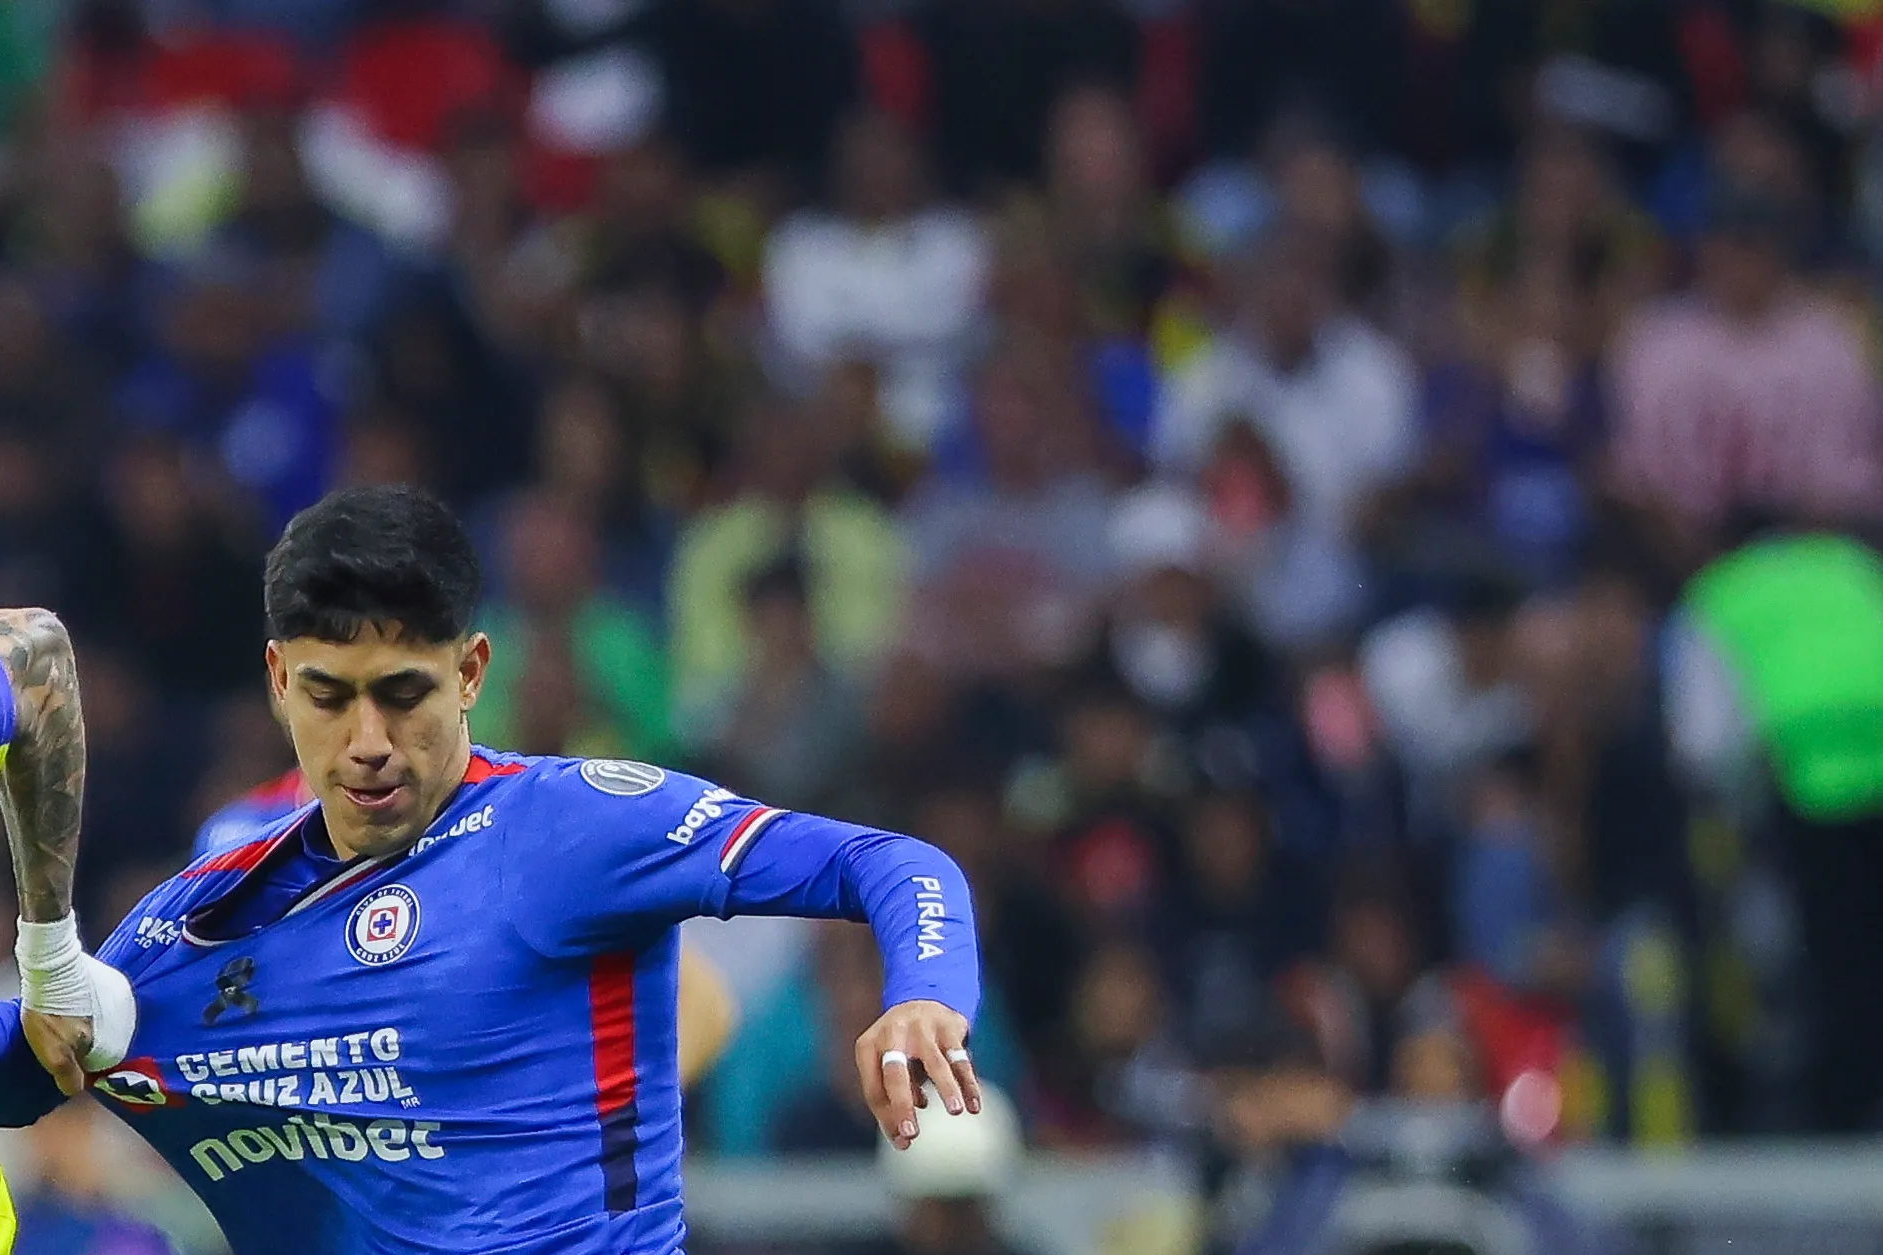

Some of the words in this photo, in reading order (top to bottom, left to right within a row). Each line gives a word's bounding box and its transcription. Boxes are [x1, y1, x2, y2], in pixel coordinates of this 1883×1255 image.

[911, 876, 945, 961] PIRMA
[175, 1027, 401, 1082] CEMENTO
[190, 1074, 301, 1107] CRUZ
[307, 1066, 414, 1106] AZUL
[189, 1113, 446, 1182] novibet
